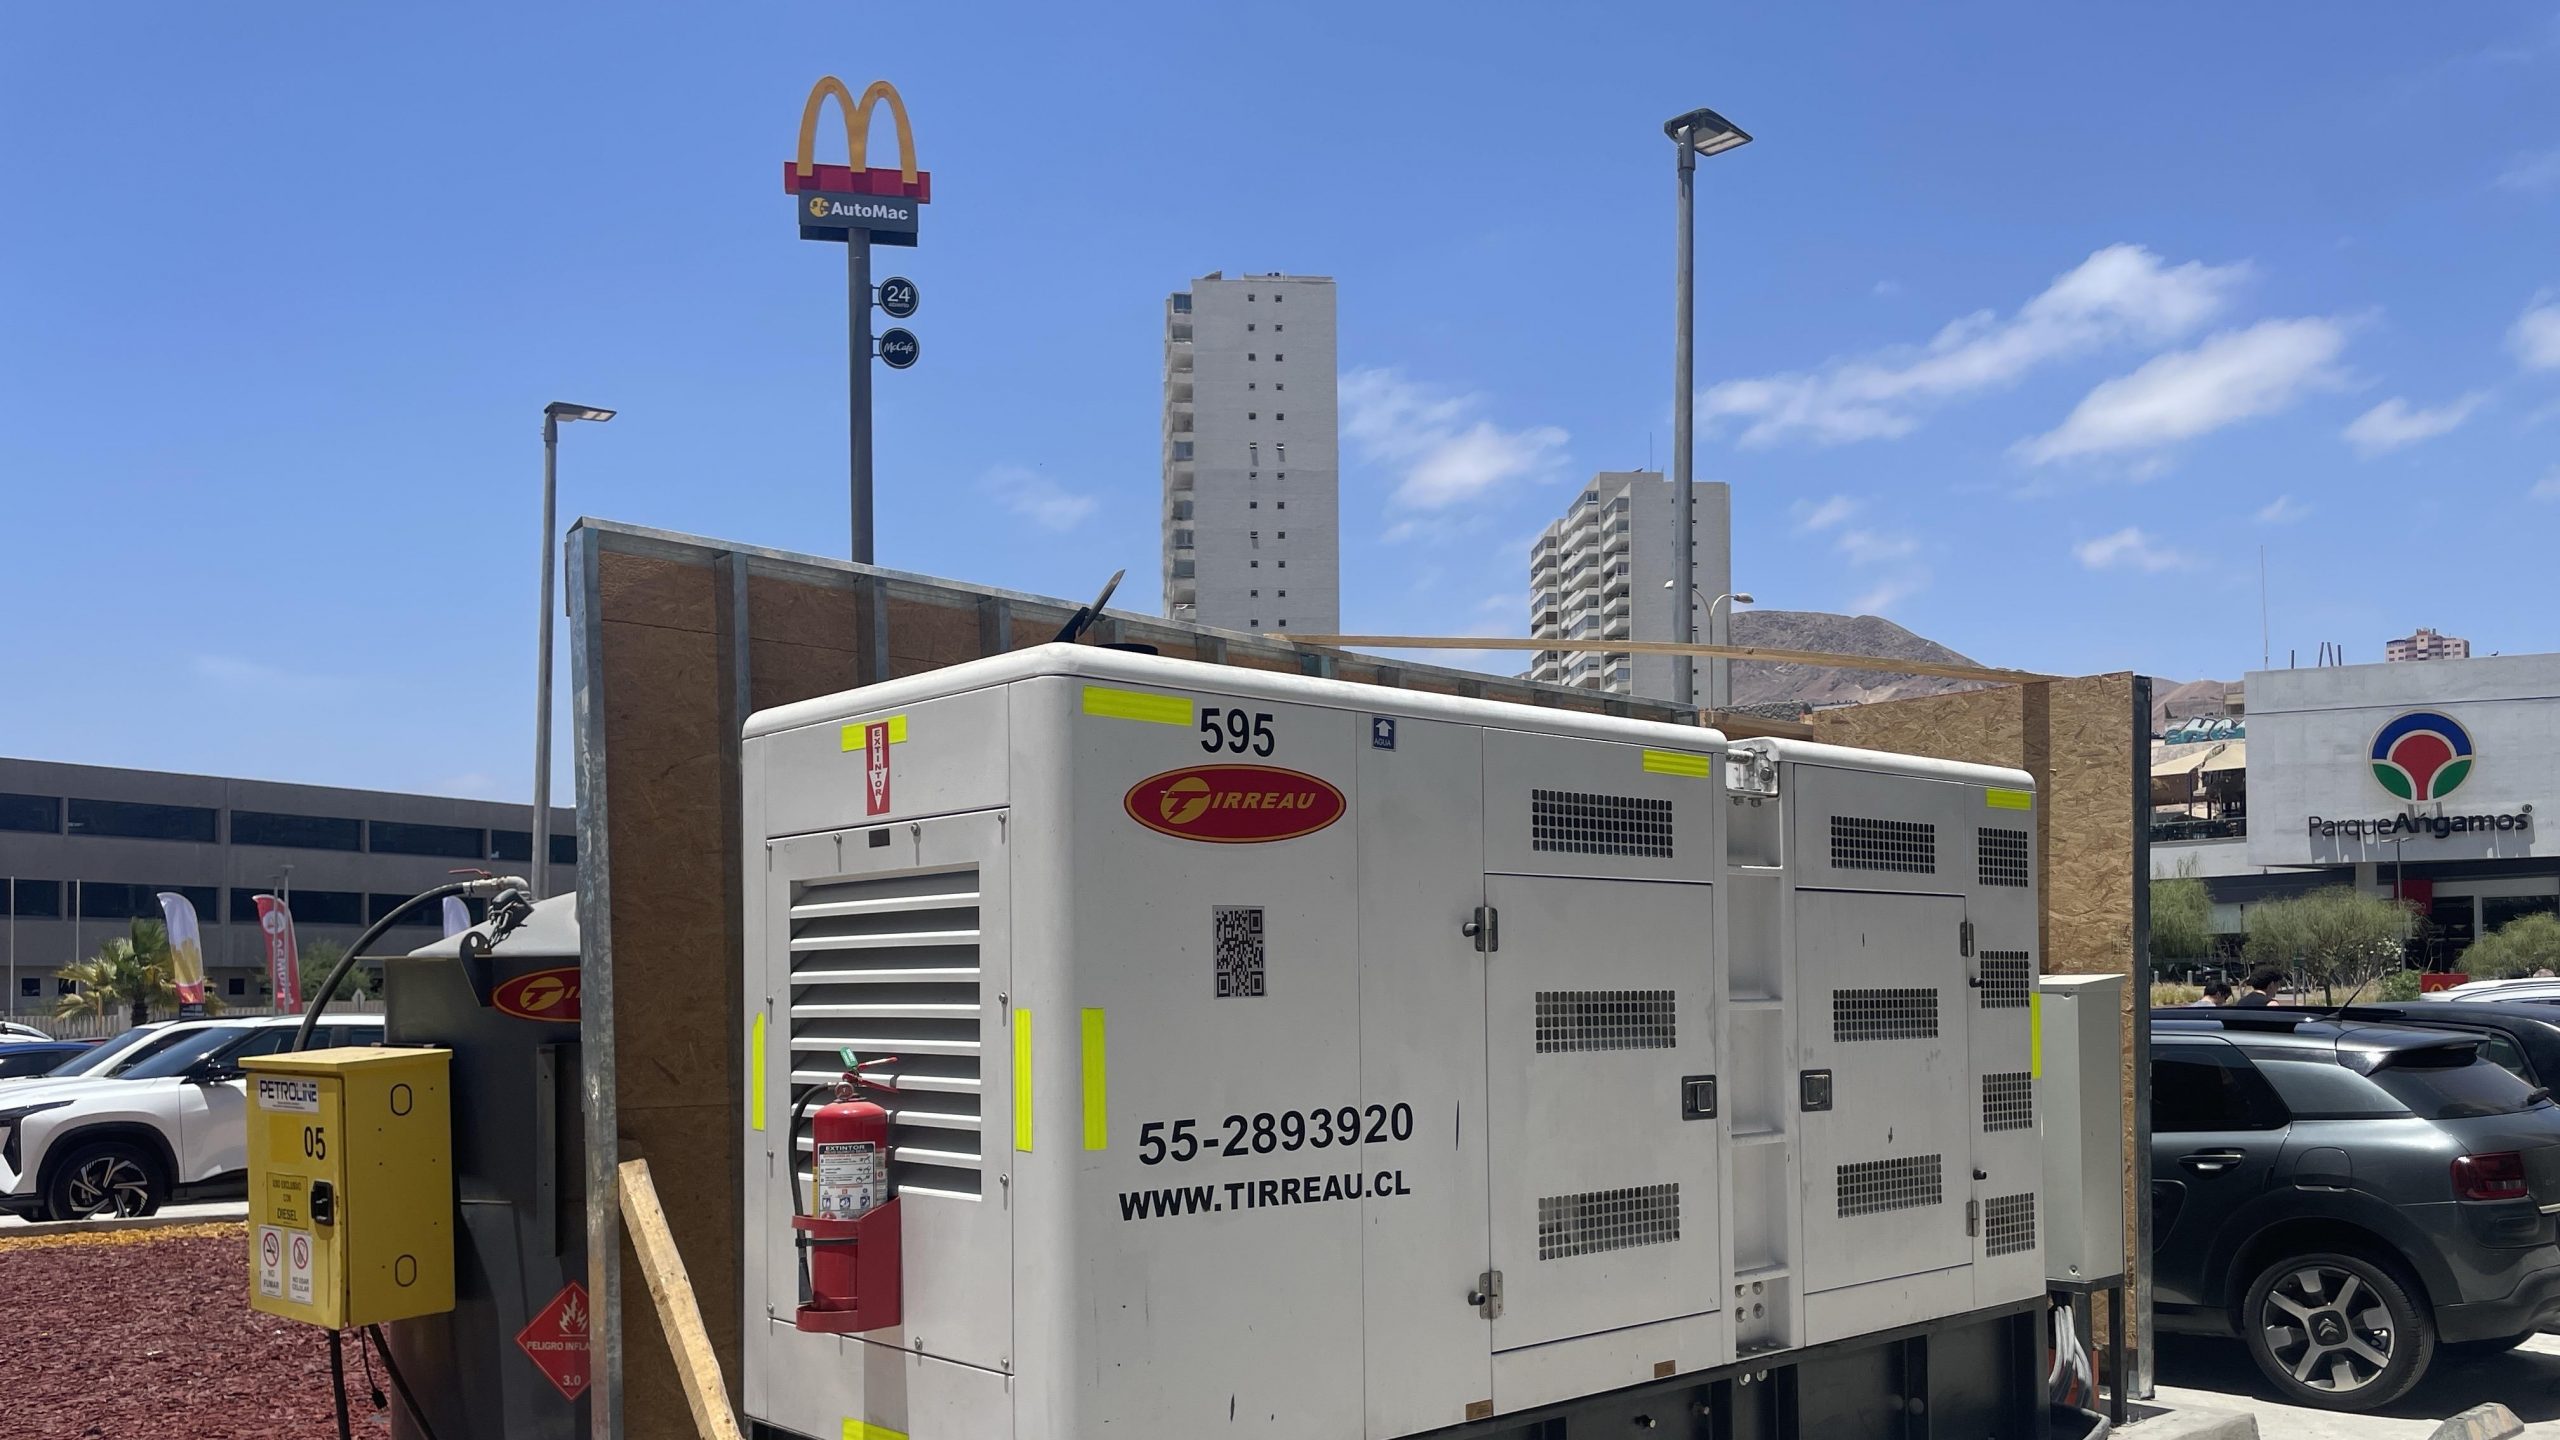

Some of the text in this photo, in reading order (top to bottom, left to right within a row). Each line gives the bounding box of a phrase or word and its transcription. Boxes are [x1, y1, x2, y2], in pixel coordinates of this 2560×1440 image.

[831, 202, 908, 220] AutoMac
[887, 286, 911, 302] 24
[1200, 708, 1275, 757] 595
[1374, 738, 1391, 746] AGUA
[874, 729, 882, 796] EXTINTOR
[1160, 777, 1316, 824] TIRREAU
[304, 1126, 326, 1160] 05
[1139, 1103, 1413, 1165] 55-2893920
[1119, 1171, 1410, 1221] WWW.TIRREAU.CL
[277, 1208, 298, 1221] DIESEL
[527, 1341, 563, 1350] PELIGRO
[563, 1375, 581, 1386] 3.0
